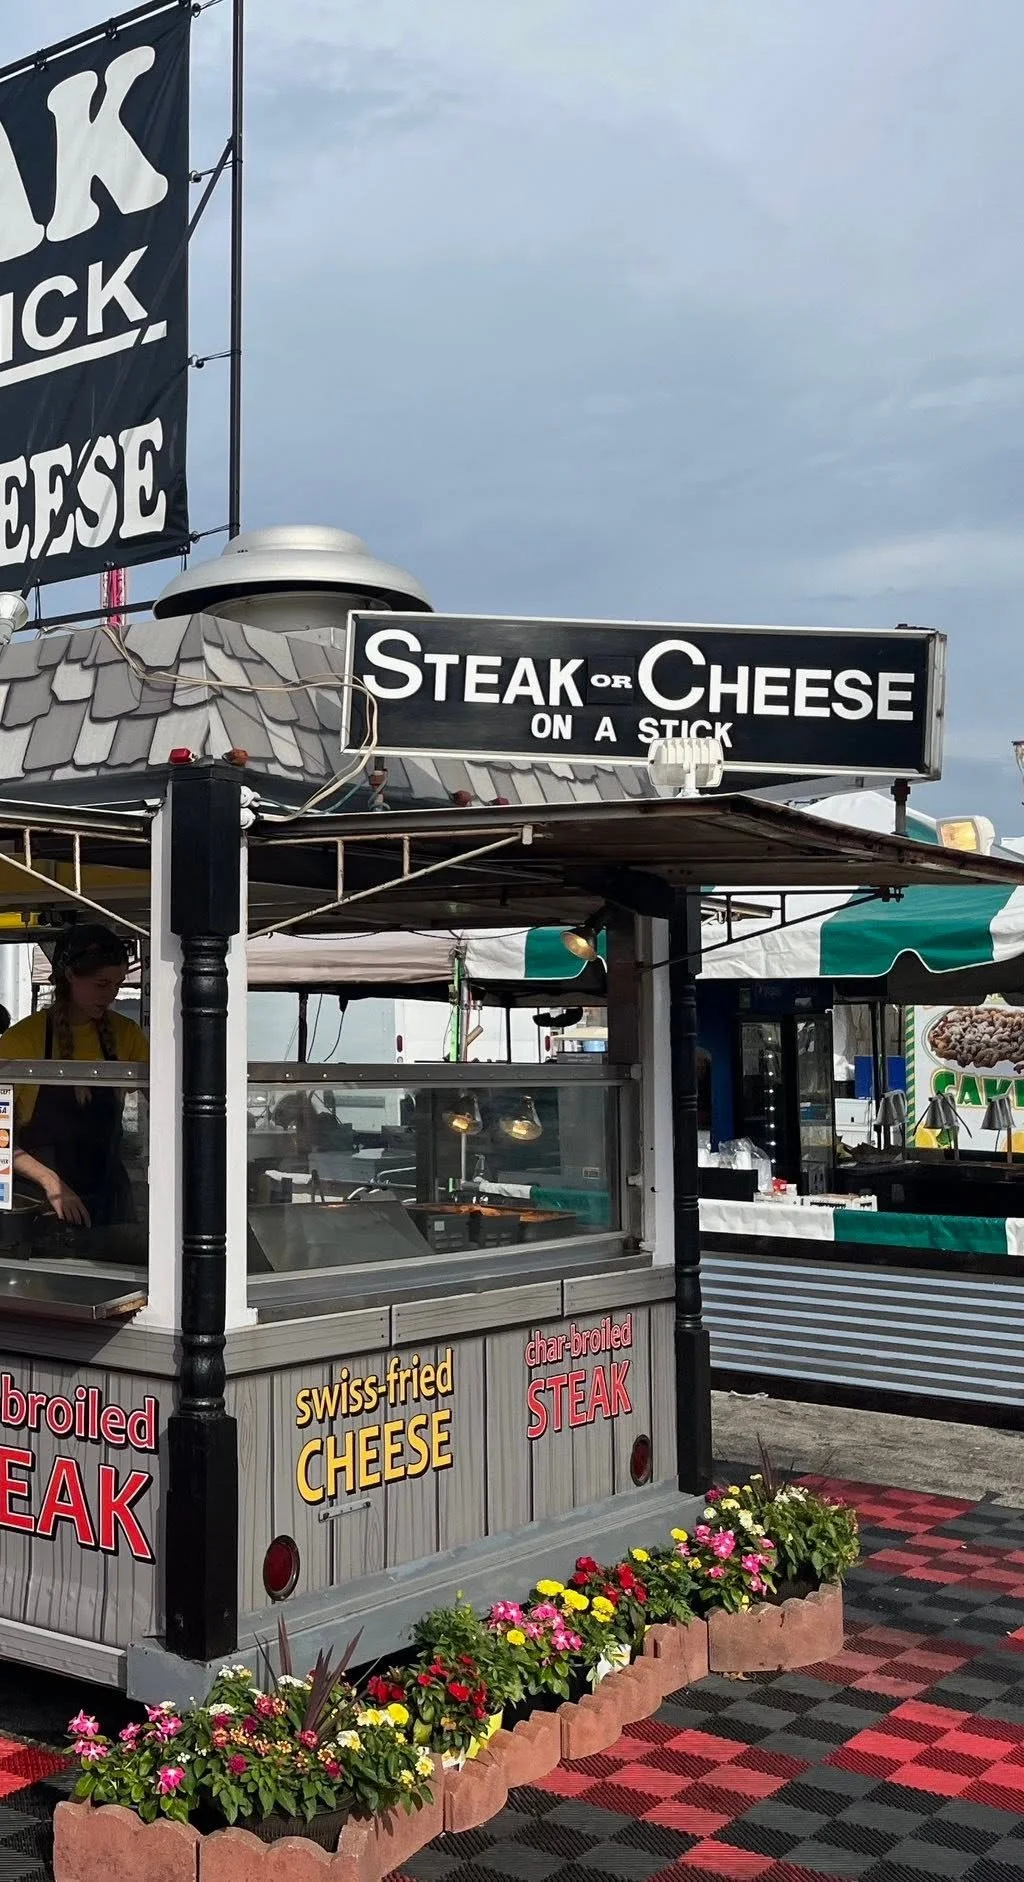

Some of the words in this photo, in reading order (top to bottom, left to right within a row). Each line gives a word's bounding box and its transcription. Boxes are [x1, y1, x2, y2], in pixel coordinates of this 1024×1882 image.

[362, 628, 584, 707] STEAK
[589, 672, 632, 690] OR
[637, 639, 914, 721] CHEESE
[531, 713, 572, 740] ON
[594, 716, 617, 742] A
[637, 716, 733, 748] STICK
[524, 1312, 633, 1370] char-broiled
[295, 1347, 454, 1428] swiss-fried
[525, 1359, 633, 1440] STEAK
[296, 1408, 454, 1505] CHEESE
